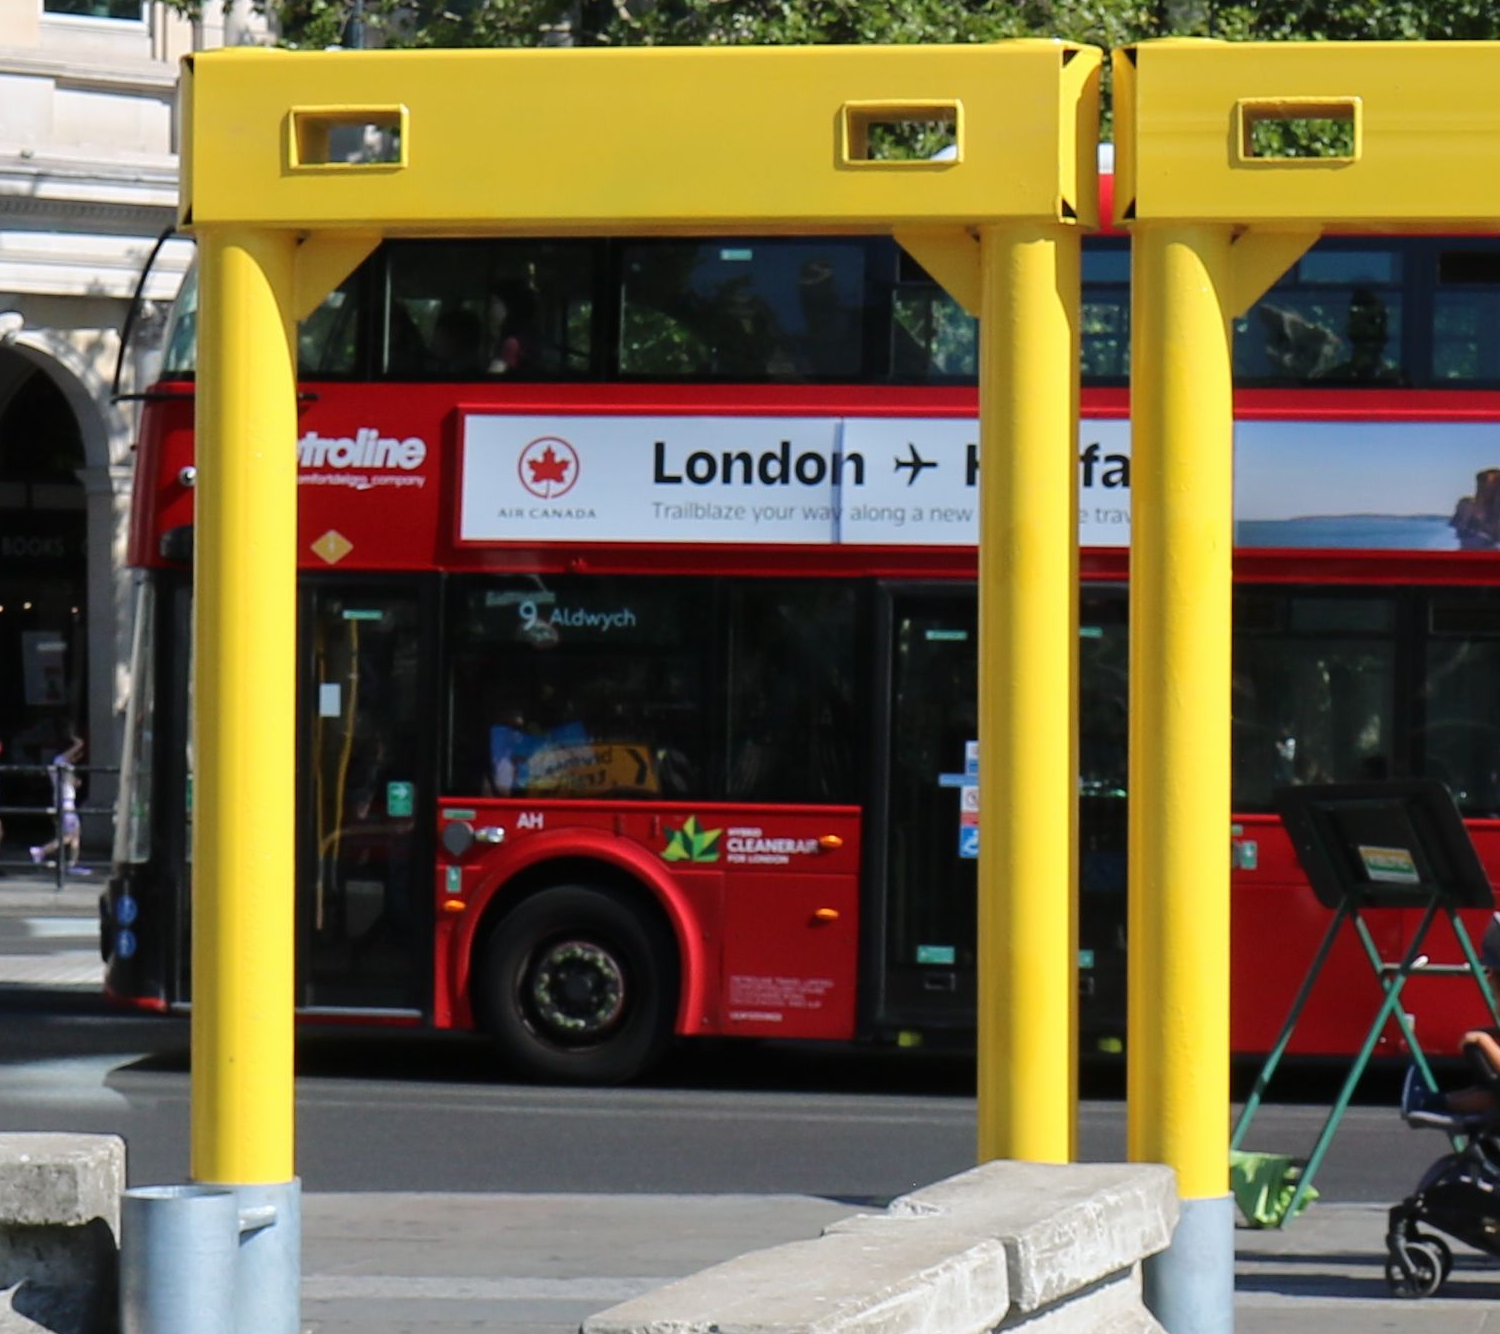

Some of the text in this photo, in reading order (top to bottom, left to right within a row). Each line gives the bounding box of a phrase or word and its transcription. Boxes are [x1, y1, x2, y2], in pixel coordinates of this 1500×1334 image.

[297, 427, 426, 469] troline
[653, 440, 865, 486] London
[497, 507, 597, 520] AIR CANADA
[651, 501, 746, 521] Trailblaze
[750, 505, 795, 524] your
[802, 505, 841, 524] way
[850, 503, 909, 525] along
[912, 509, 924, 522] a
[929, 507, 972, 523] new
[519, 599, 538, 630] 9
[550, 607, 636, 631] Aldwych
[516, 812, 544, 829] AH
[747, 854, 789, 865] LONDON
